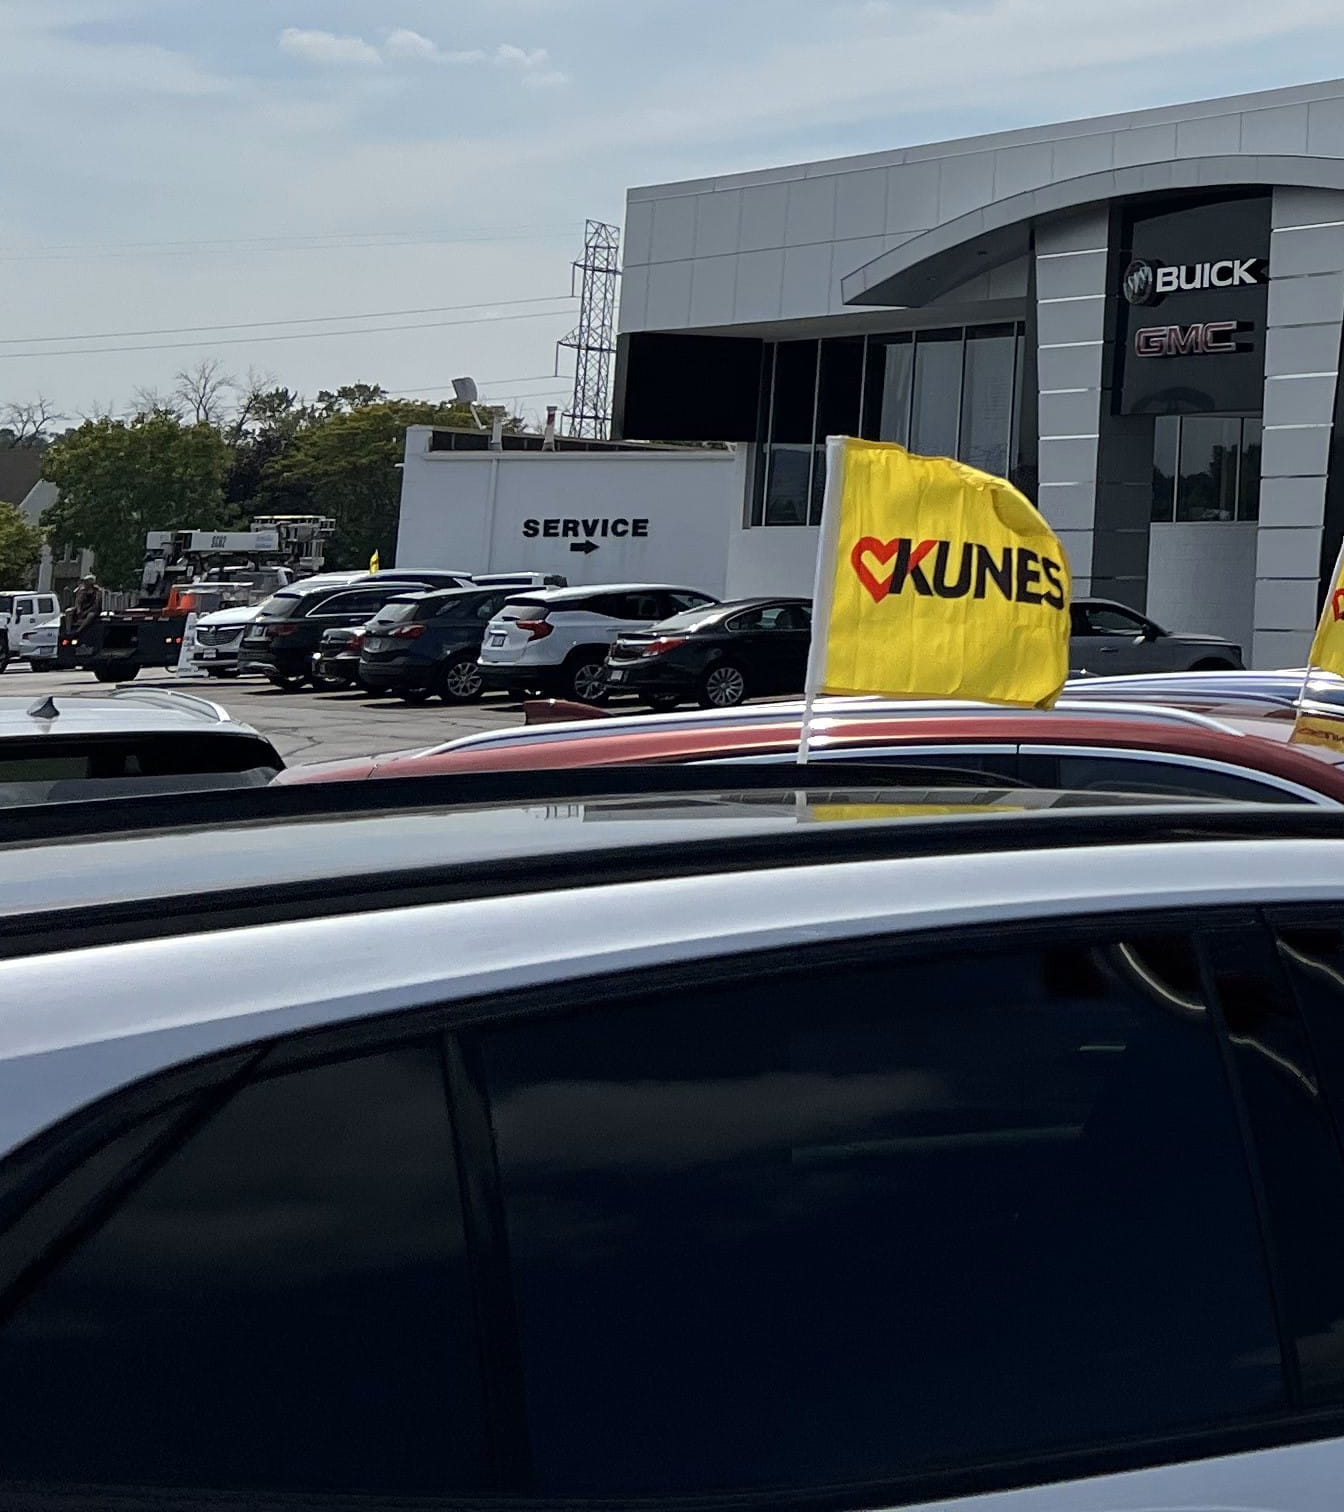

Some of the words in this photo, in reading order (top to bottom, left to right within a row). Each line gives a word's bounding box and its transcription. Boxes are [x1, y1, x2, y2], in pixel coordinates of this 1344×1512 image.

[1156, 258, 1258, 292] BUICK
[1135, 320, 1238, 357] GMC
[522, 518, 649, 538] SERVICE
[888, 538, 1064, 610] KUNES
